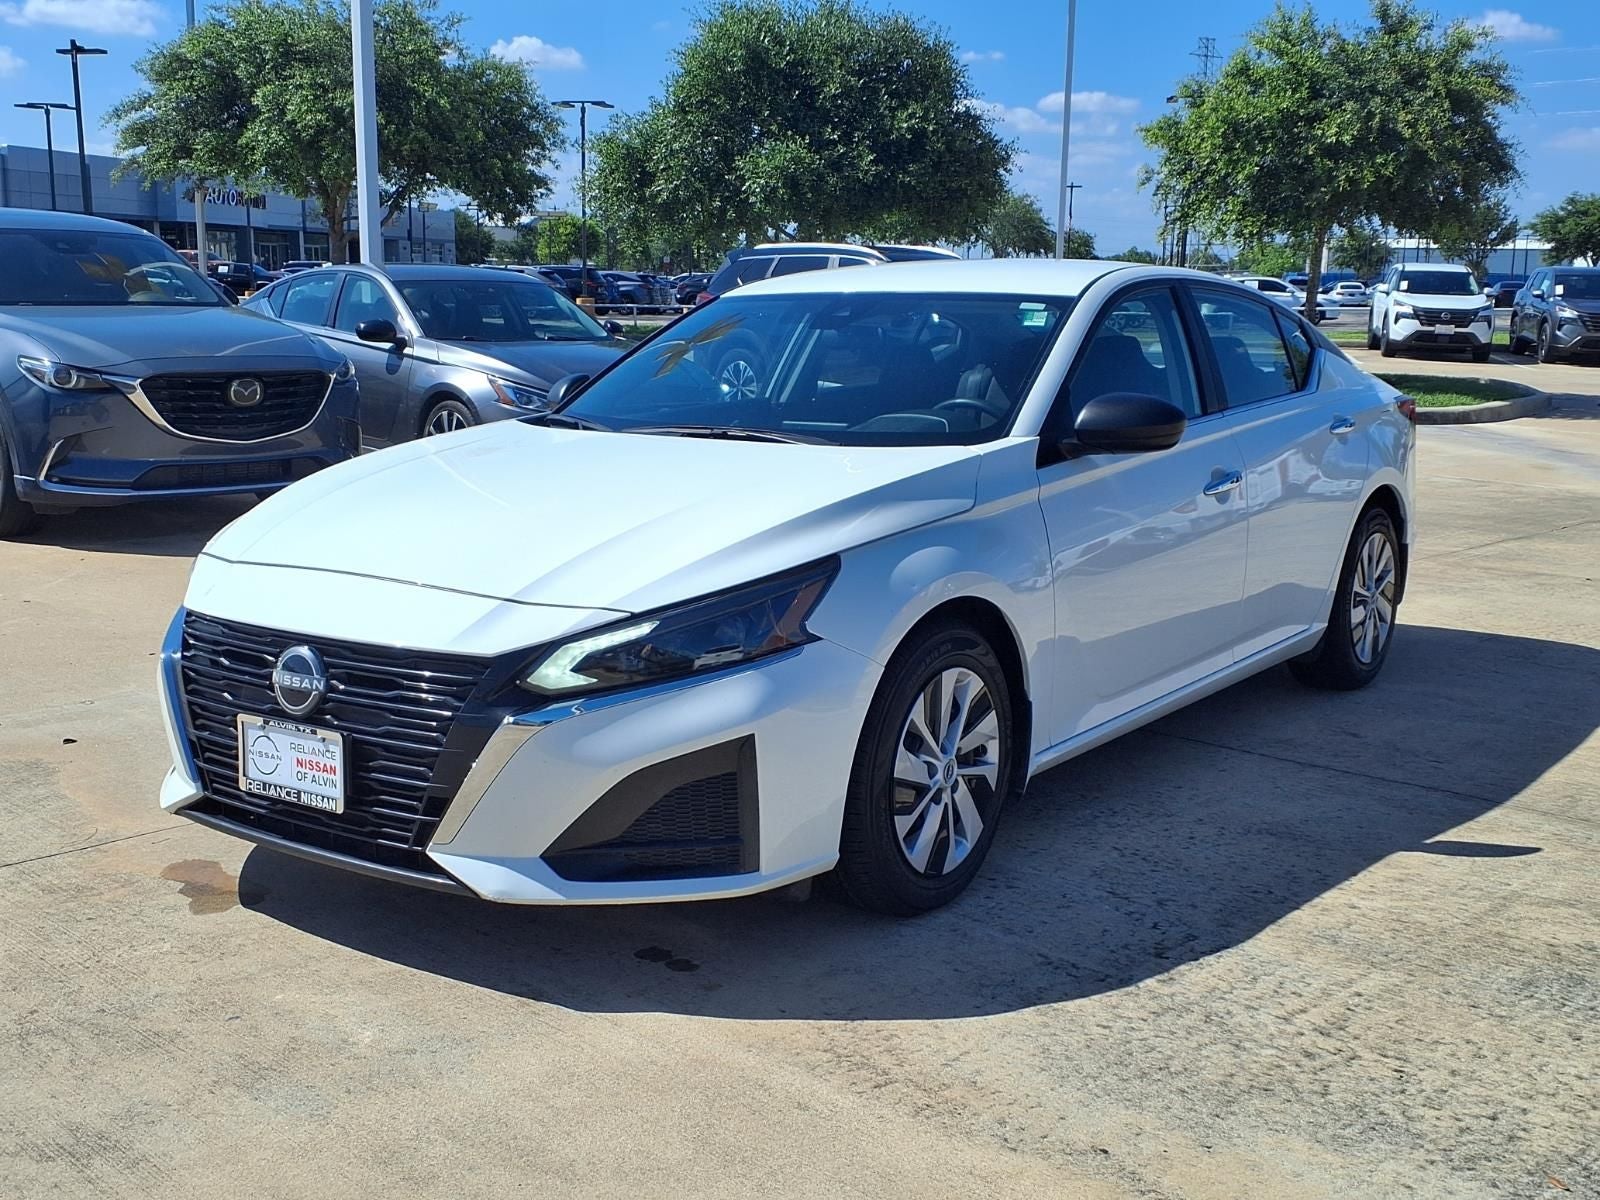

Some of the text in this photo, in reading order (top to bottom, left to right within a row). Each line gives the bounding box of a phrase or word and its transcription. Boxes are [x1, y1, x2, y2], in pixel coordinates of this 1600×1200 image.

[272, 669, 324, 690] NISSAN
[298, 726, 312, 734] TX
[248, 748, 282, 761] NISSAN
[289, 742, 337, 760] RELIANCE
[295, 757, 337, 776] NISSAN
[296, 770, 337, 789] OF ALVIN
[246, 779, 336, 811] RELIANCE NISSAN
